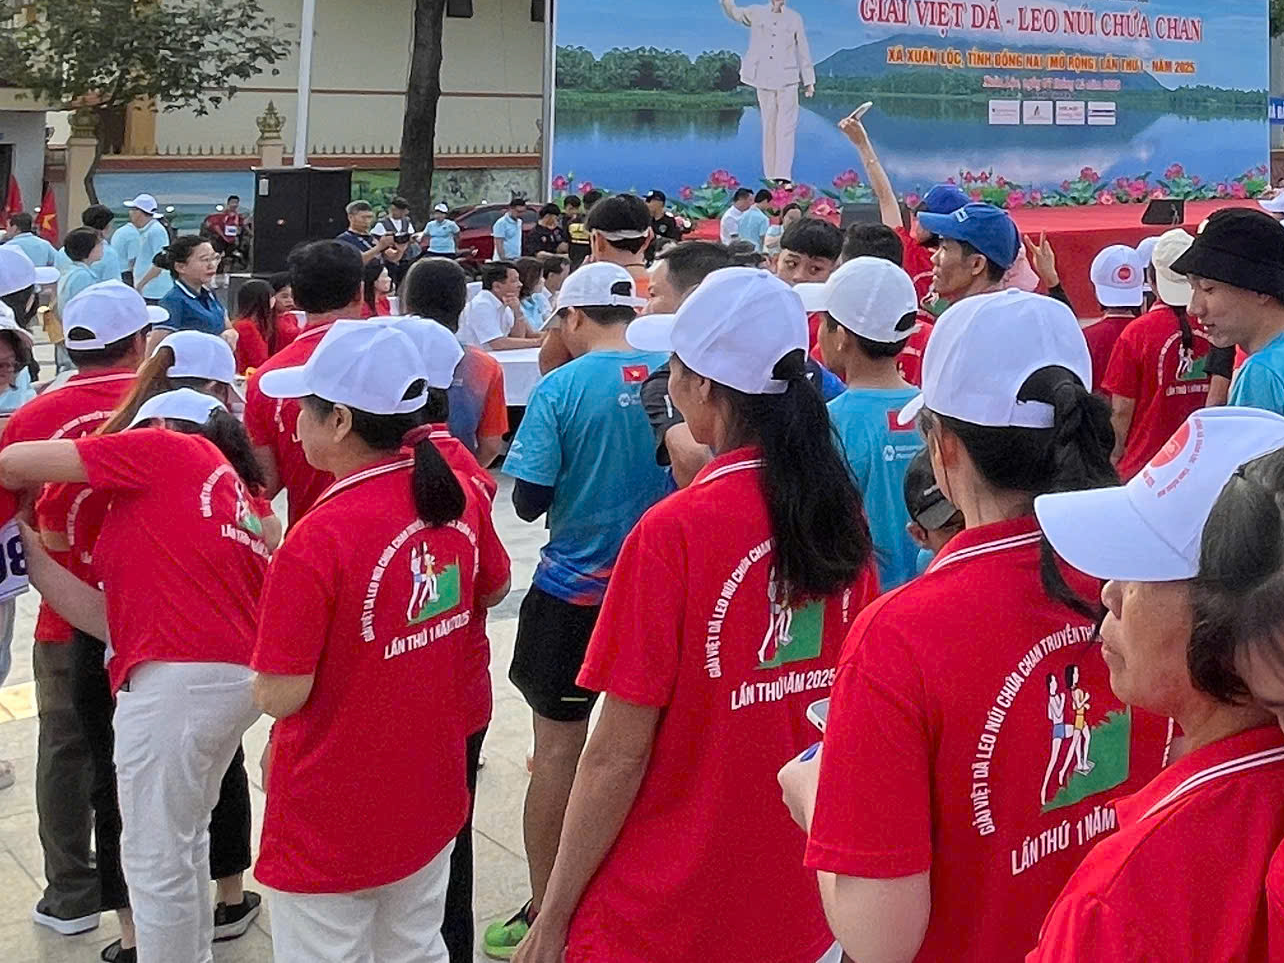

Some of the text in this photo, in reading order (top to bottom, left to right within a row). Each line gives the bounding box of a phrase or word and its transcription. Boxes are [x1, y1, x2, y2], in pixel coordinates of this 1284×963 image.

[1018, 7, 1057, 33] LEO
[1063, 4, 1095, 35] NÚI
[1155, 16, 1202, 41] CHAN
[888, 45, 904, 62] XÃ
[907, 46, 937, 64] XUÂN
[994, 49, 1023, 67] ĐỒNG
[1152, 56, 1172, 73] NĂM
[720, 579, 738, 601] NÚI
[712, 598, 729, 620] LEO
[384, 636, 406, 660] LẦN
[407, 627, 428, 651] THỨ
[429, 629, 435, 643] 1
[1040, 622, 1082, 656] TRUYỀN
[1018, 643, 1044, 677] CHAN
[731, 681, 755, 711] LẦN
[756, 676, 784, 702] THỨ
[806, 668, 836, 689] 2025
[985, 705, 1008, 734] NÚI
[977, 734, 997, 761] LEO
[971, 761, 990, 780] DÃ
[970, 783, 992, 811] VIỆT
[971, 808, 996, 837] GIẢI
[1011, 805, 1116, 876] LẦN THỨ 1 NĂM
